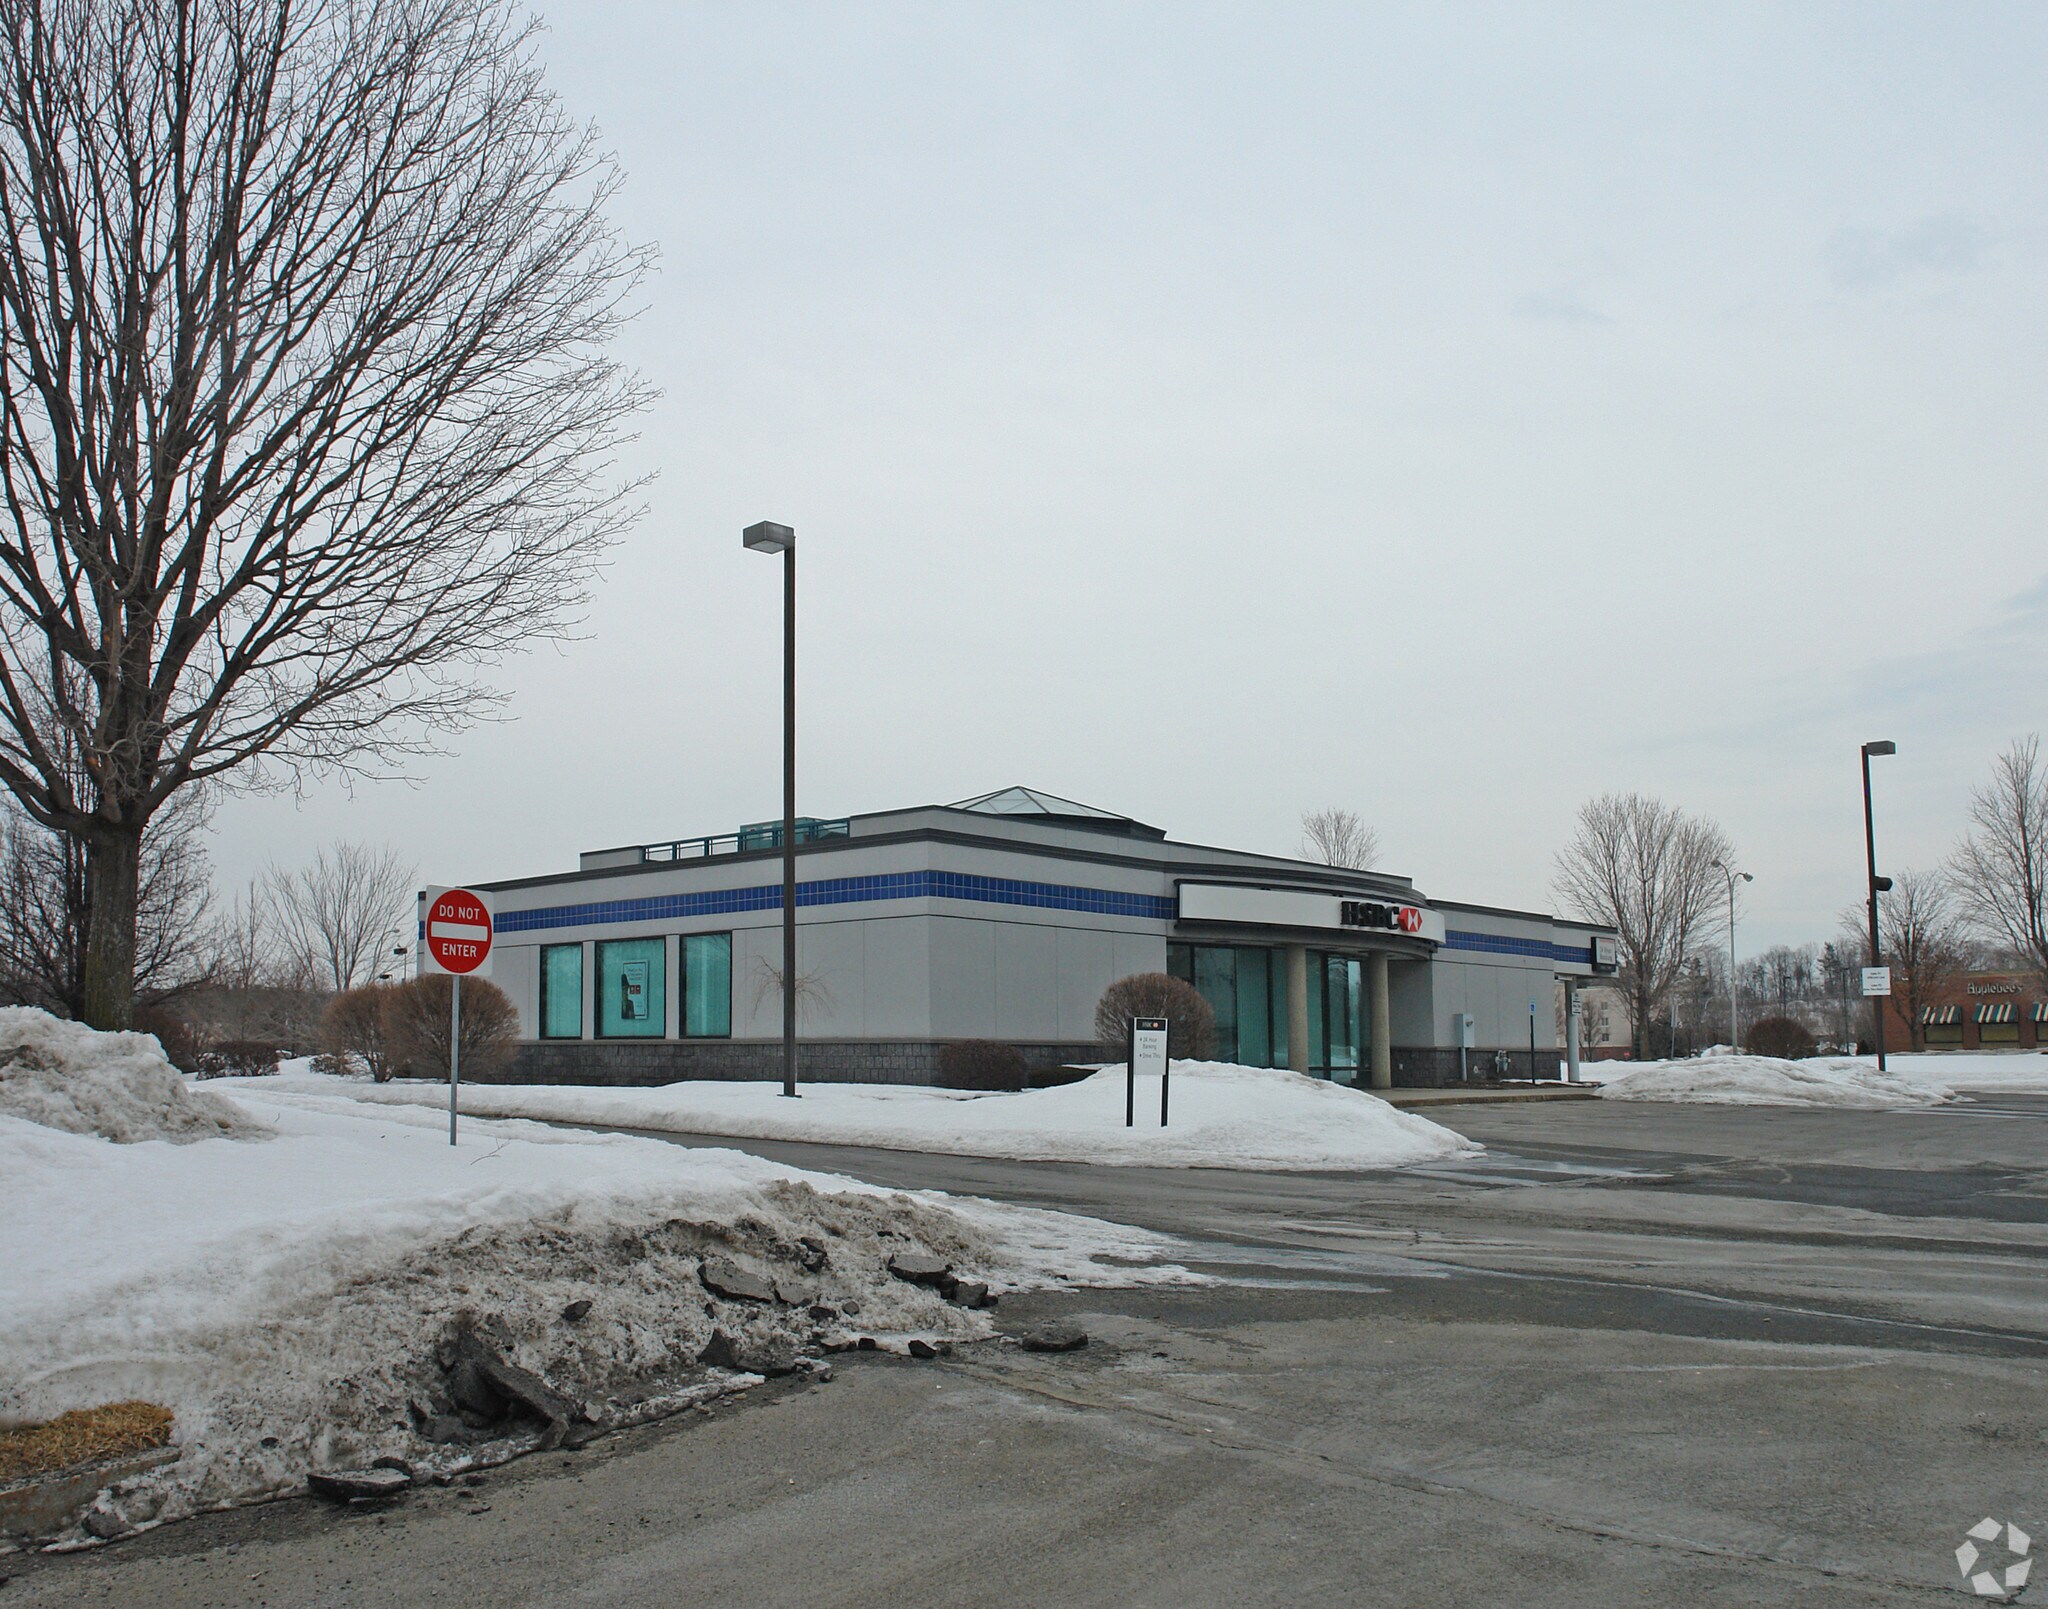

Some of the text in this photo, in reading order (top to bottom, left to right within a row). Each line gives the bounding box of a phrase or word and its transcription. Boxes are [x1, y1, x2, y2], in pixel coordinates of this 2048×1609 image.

[439, 904, 480, 920] DO NOT
[442, 943, 477, 957] ENTER
